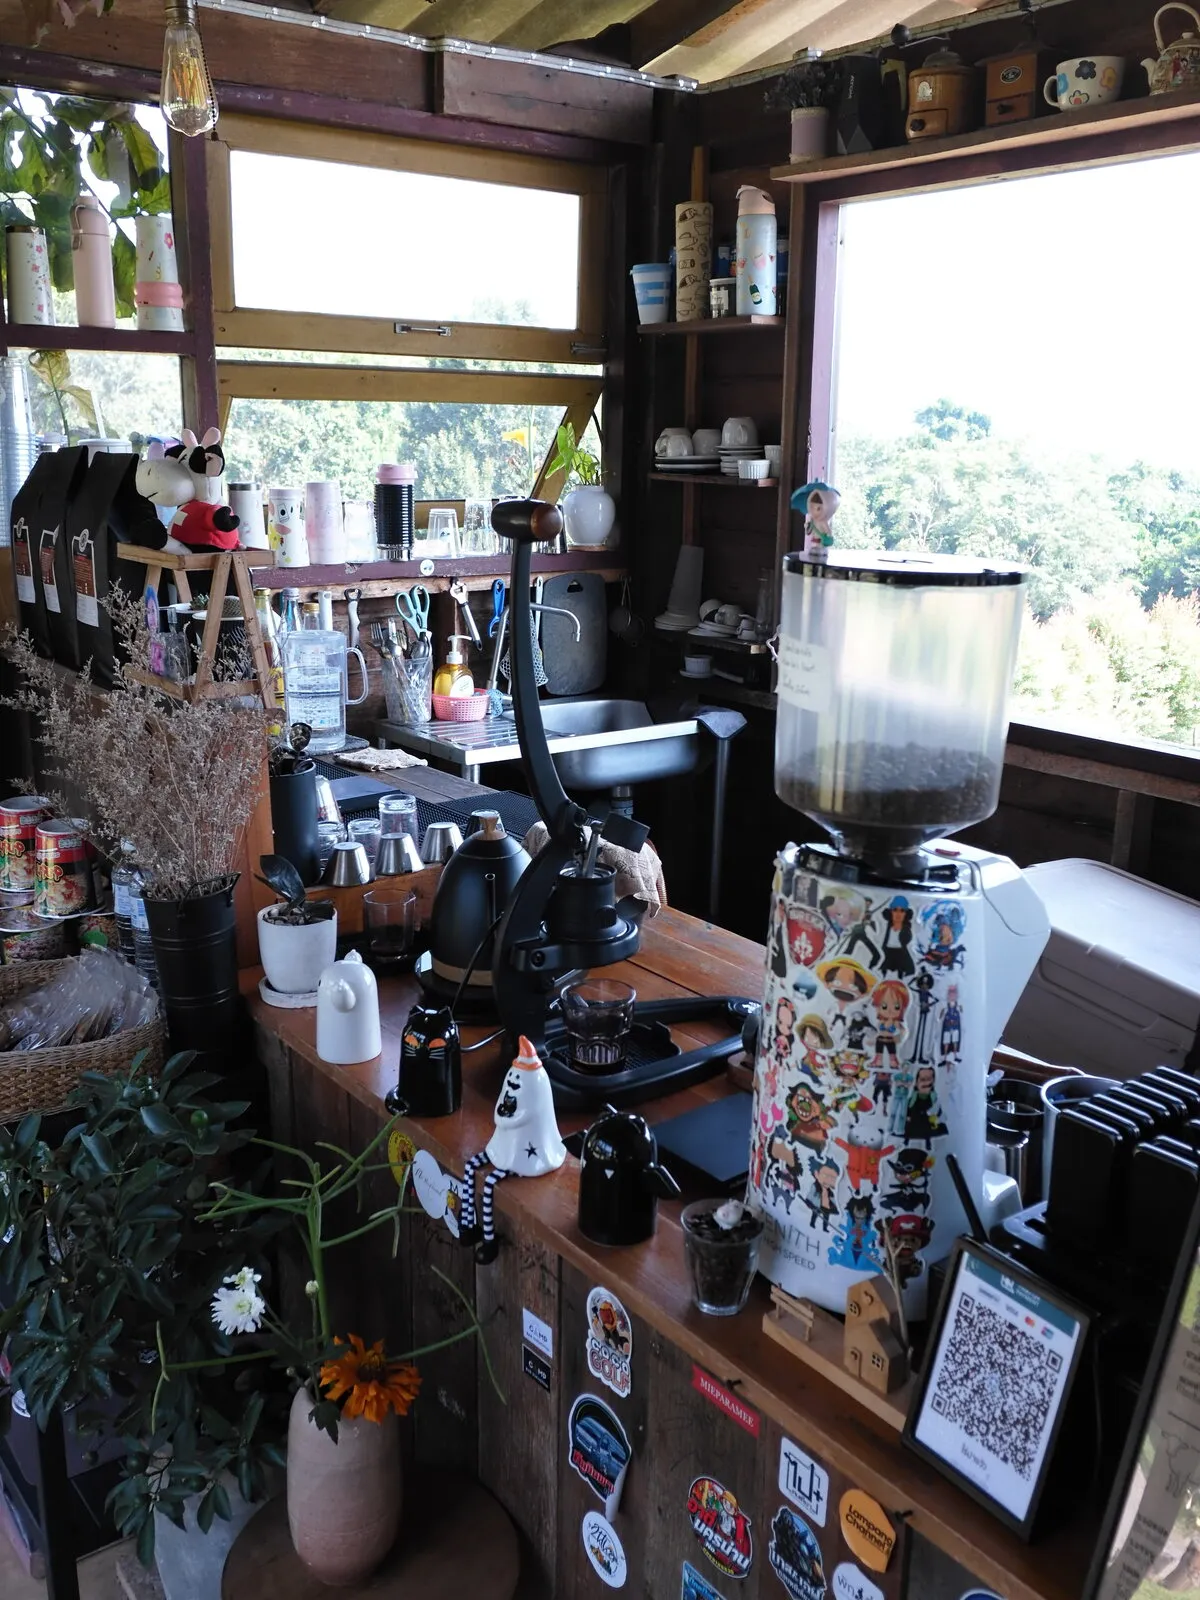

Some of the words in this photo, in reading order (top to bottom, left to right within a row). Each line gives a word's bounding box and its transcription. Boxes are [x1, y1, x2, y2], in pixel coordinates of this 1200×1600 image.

[783, 1249, 816, 1271] SPEED
[589, 1348, 630, 1394] GOLF
[590, 1337, 629, 1376] COCO
[700, 1376, 754, 1428] MIEPARAMEE
[693, 1517, 751, 1570] นครน่าน
[845, 1512, 887, 1551] Channel
[848, 1503, 893, 1549] Lampang
